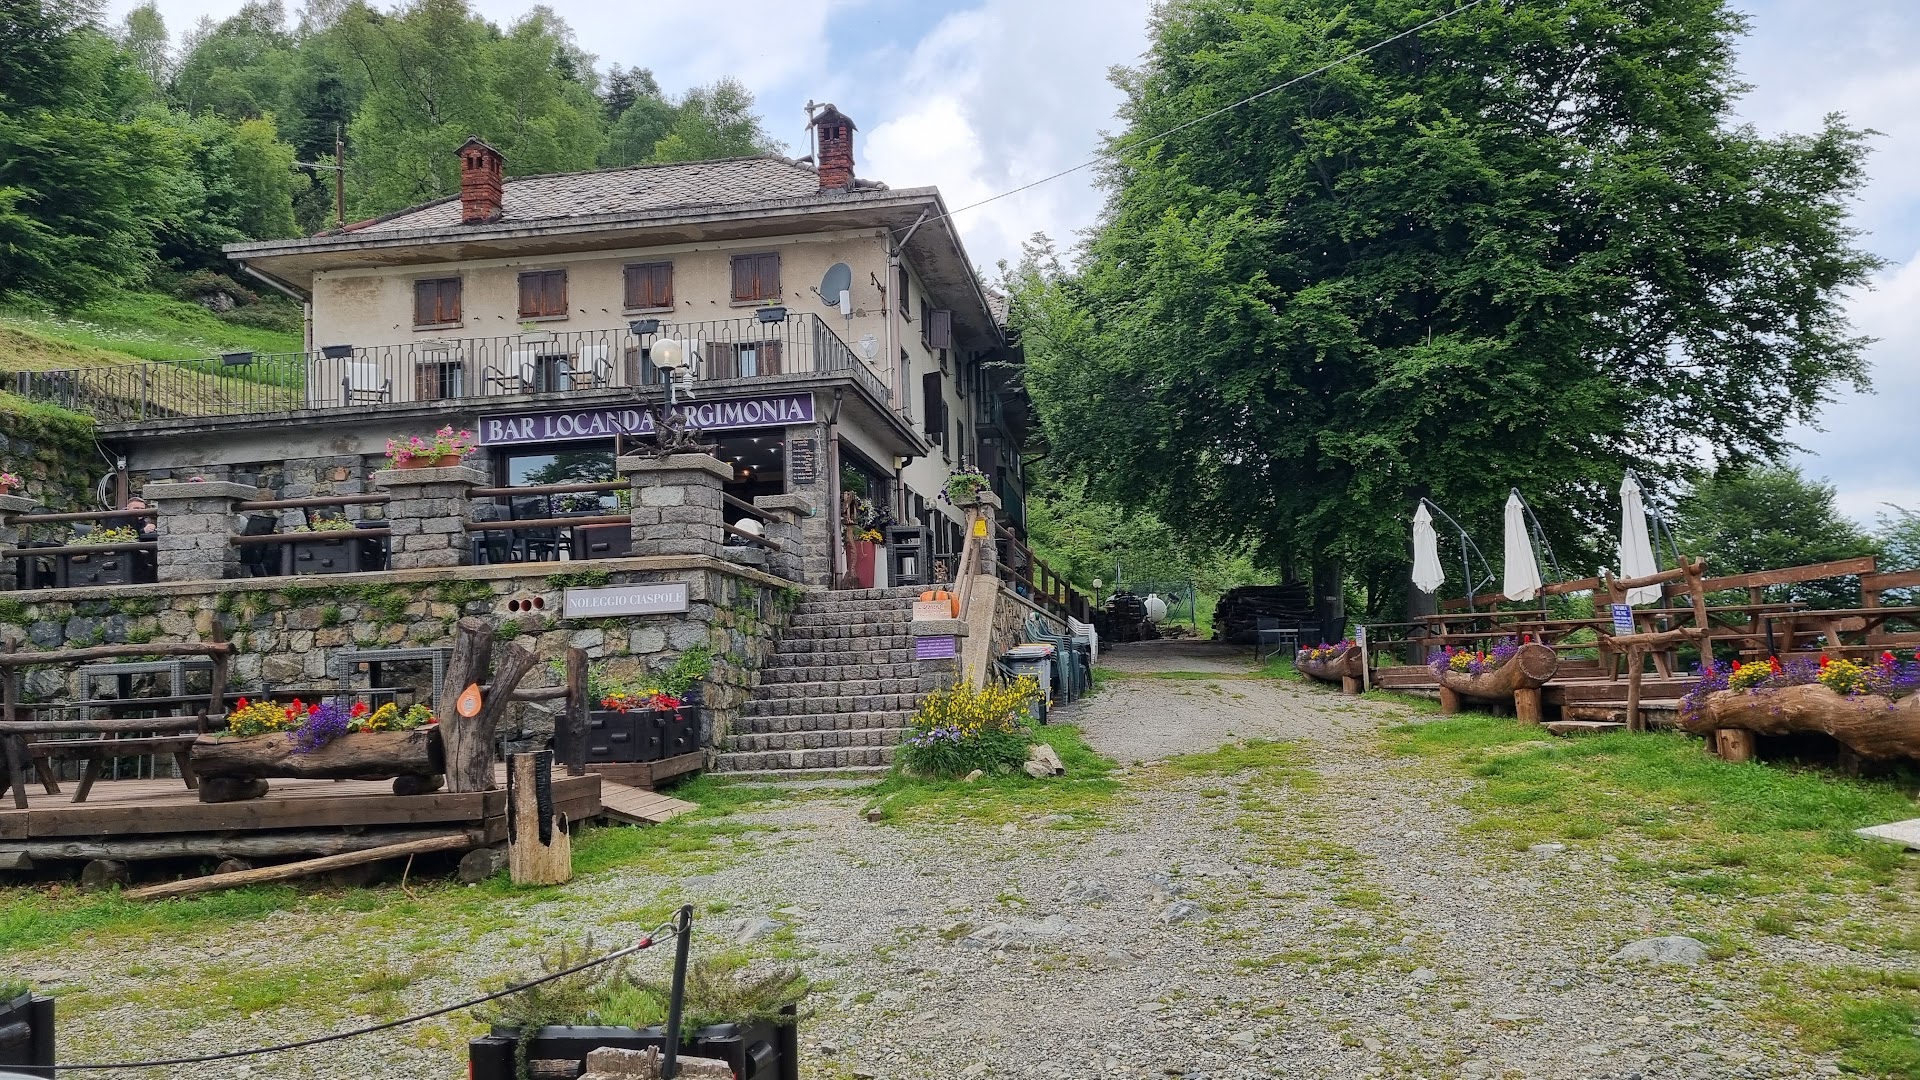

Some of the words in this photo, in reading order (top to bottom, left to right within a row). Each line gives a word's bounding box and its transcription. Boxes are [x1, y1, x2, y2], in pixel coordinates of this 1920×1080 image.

[488, 417, 535, 441] BAR
[542, 409, 654, 438] LOCANDA
[569, 595, 627, 609] NOLEGGIO
[629, 592, 683, 605] CIASPOLE
